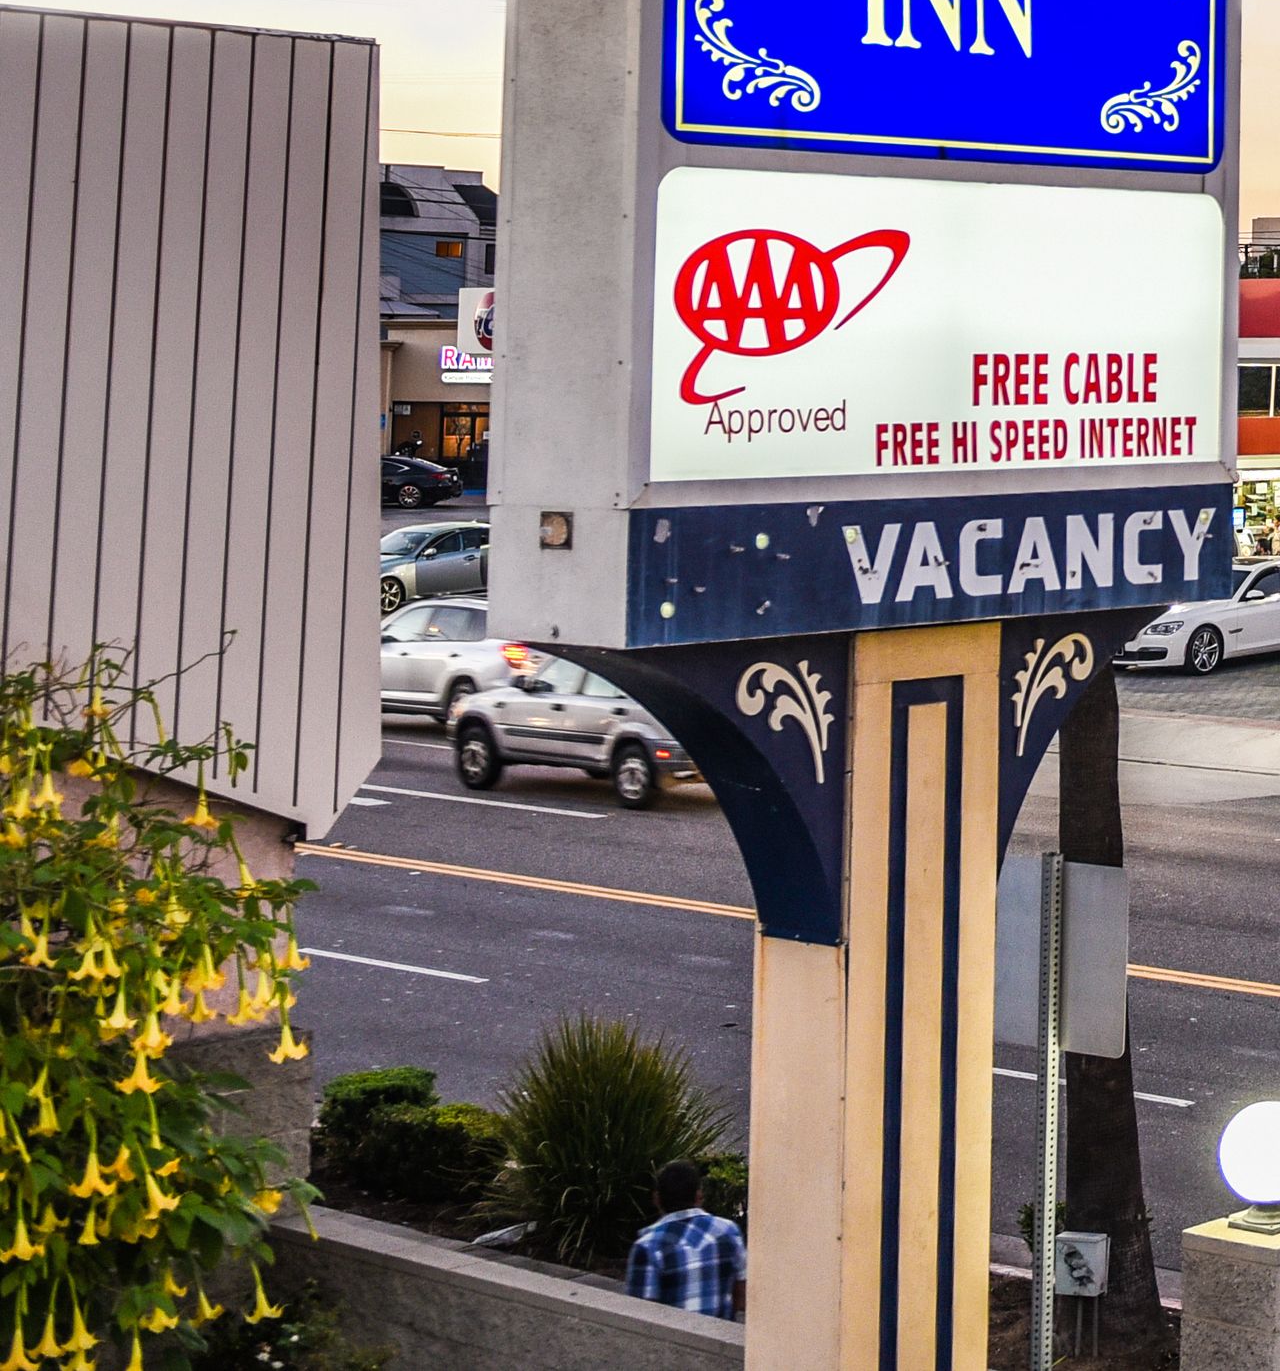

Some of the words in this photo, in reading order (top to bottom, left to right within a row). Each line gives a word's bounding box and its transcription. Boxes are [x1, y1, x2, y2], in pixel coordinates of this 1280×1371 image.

[692, 237, 825, 349] AAA
[971, 353, 1049, 406] FREE
[1063, 352, 1158, 404] CABLE
[704, 399, 847, 443] Approved
[875, 422, 940, 466] FREE
[951, 421, 978, 463] HI
[989, 419, 1068, 462] SPEED
[1079, 416, 1197, 458] INTERNET
[842, 507, 1217, 605] VACANCY
